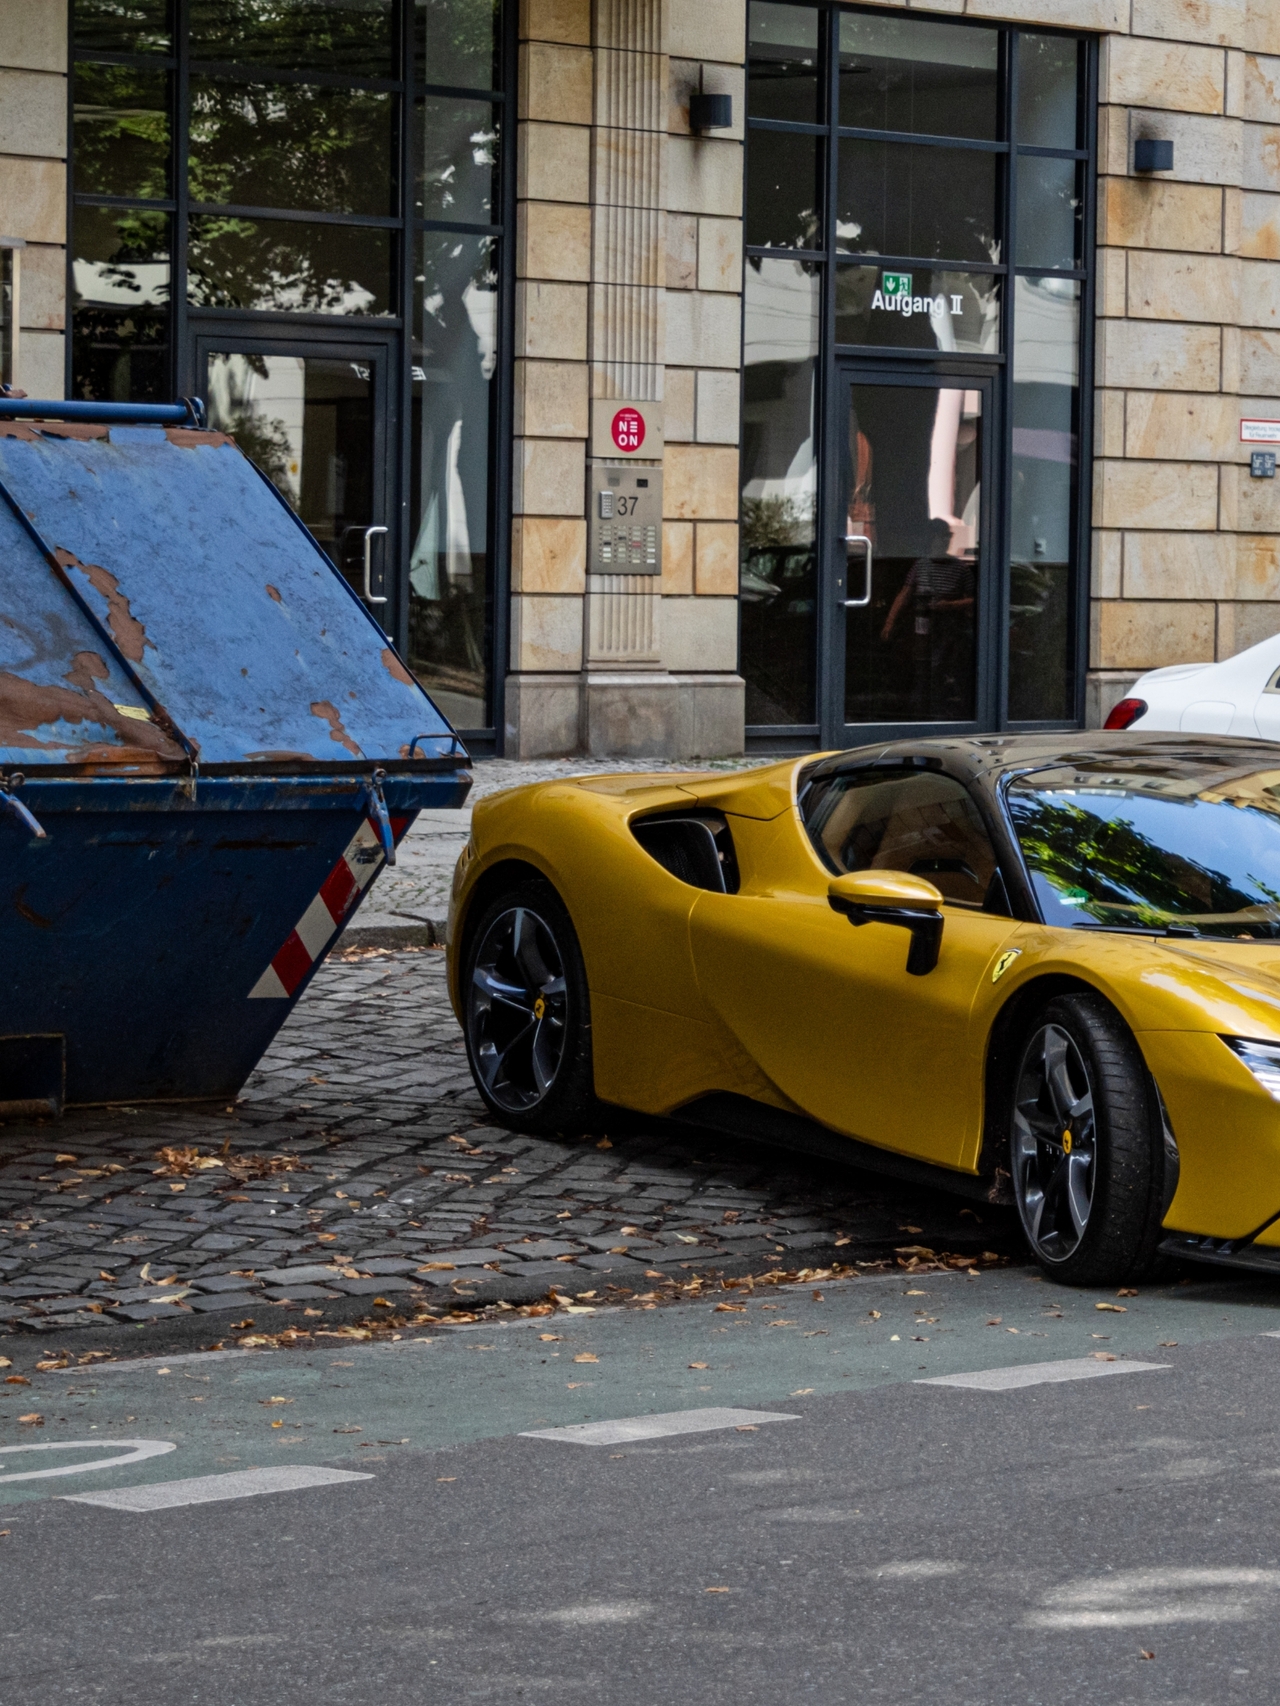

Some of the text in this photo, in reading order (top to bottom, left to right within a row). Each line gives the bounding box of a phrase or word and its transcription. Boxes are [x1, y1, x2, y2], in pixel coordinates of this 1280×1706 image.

[871, 289, 964, 318] Aufgang II
[617, 496, 639, 516] 37
